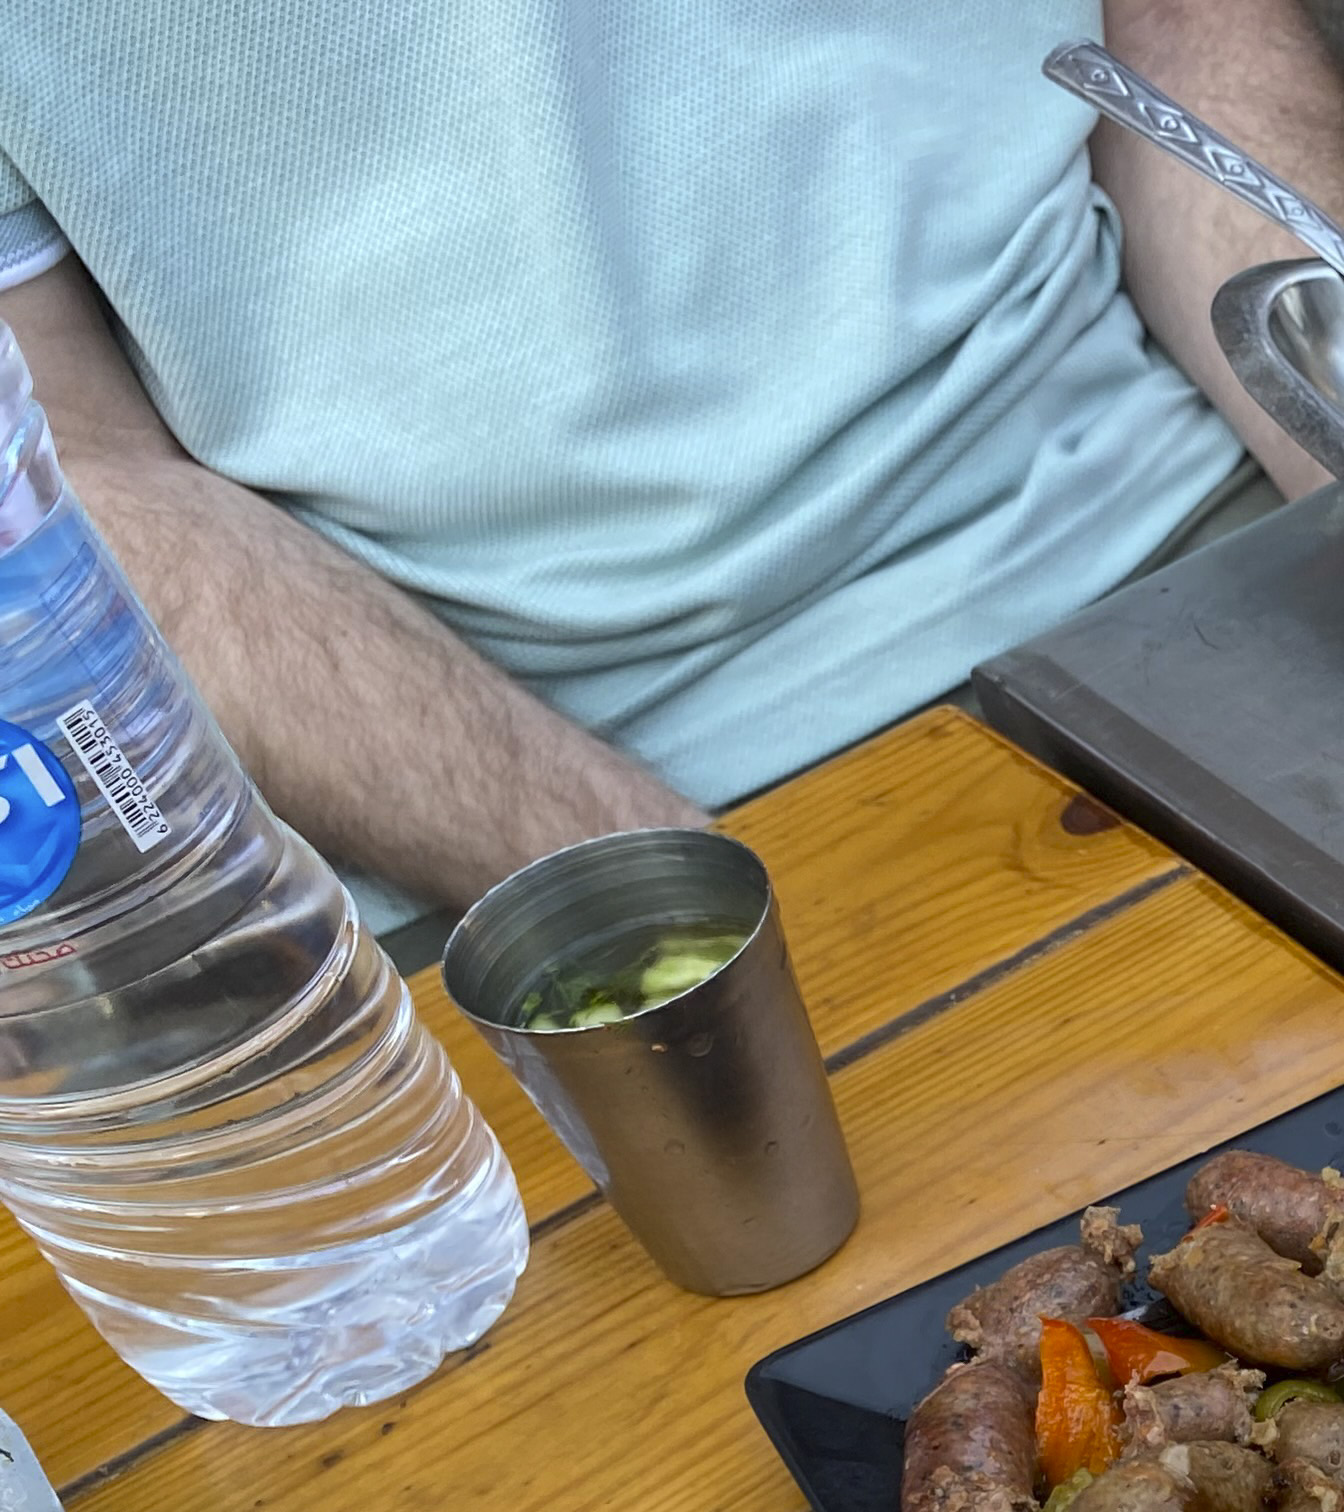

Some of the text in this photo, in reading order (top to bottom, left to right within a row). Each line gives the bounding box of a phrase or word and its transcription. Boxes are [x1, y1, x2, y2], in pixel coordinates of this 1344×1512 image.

[83, 709, 168, 834] 6 224000 453015
